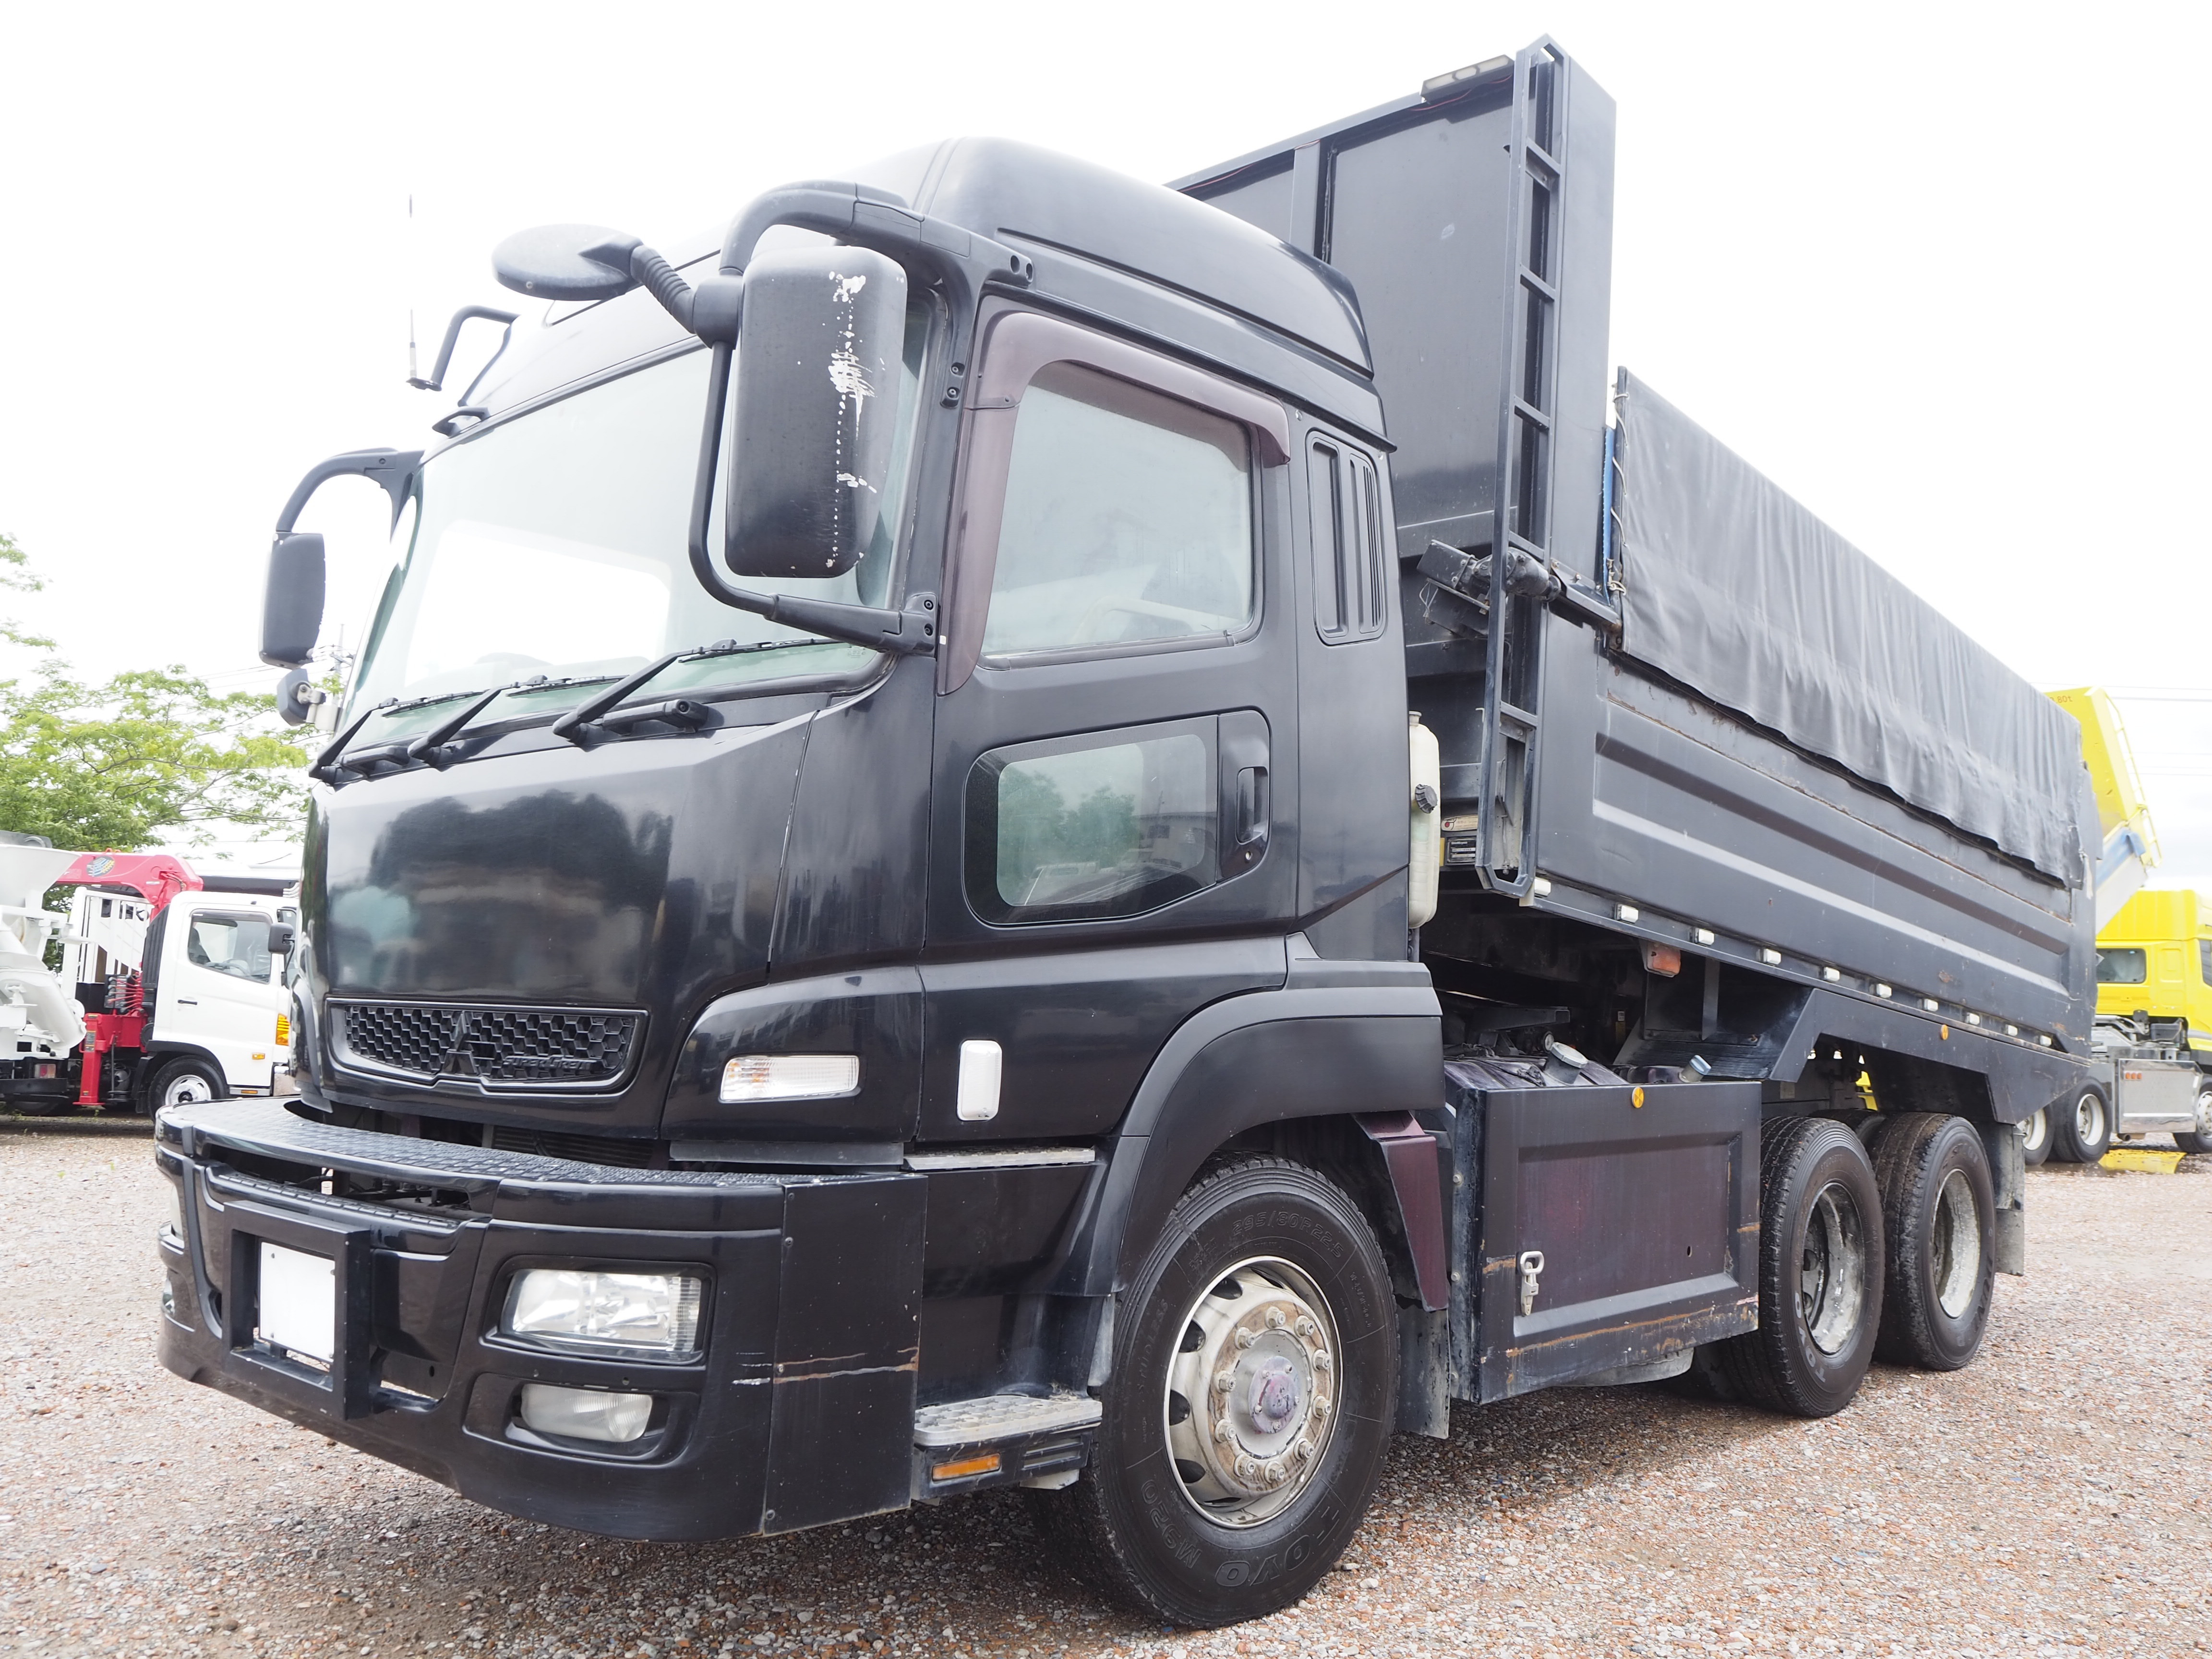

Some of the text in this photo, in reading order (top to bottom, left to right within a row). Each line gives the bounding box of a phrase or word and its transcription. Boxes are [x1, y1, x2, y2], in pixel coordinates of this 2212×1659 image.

[1794, 1290, 1826, 1383] TOYO
[1141, 1479, 1202, 1569] M920
[1214, 1506, 1340, 1587] TOYO
